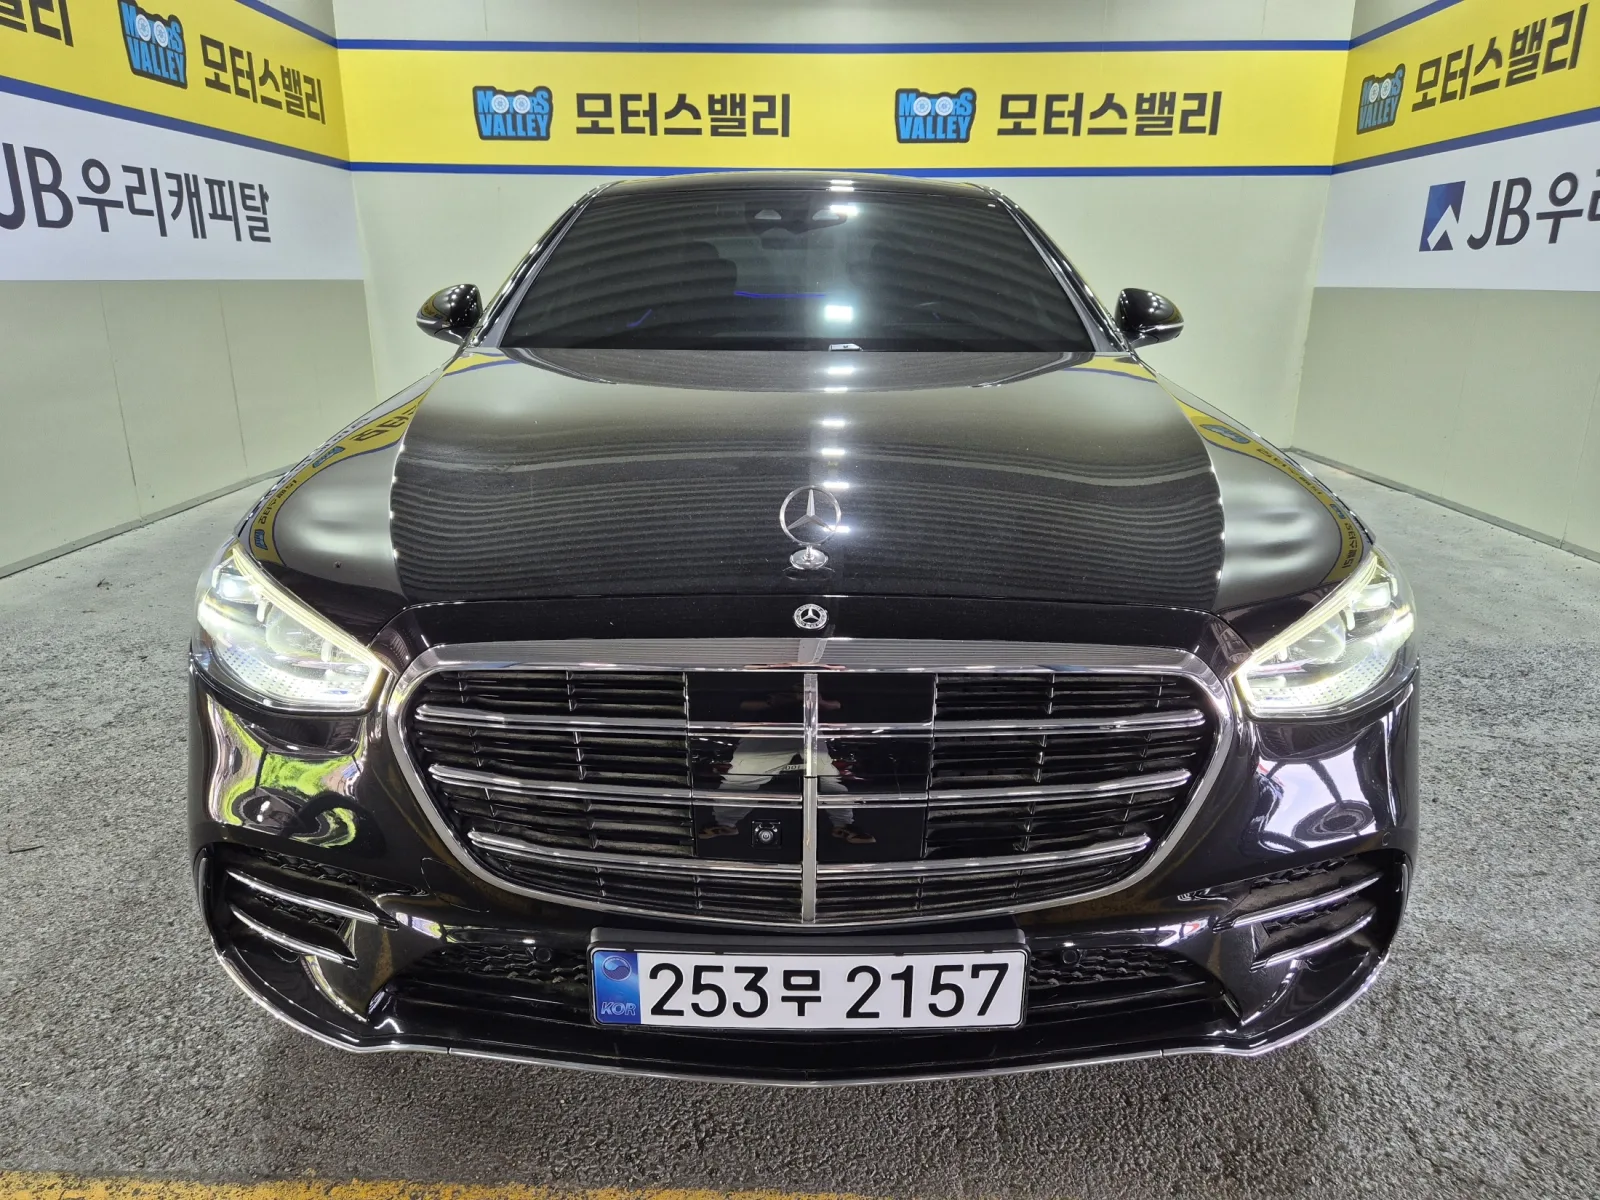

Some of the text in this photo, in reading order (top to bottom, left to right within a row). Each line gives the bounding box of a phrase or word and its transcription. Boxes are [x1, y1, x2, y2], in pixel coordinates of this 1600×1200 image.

[127, 36, 185, 83] VALLEY
[200, 34, 326, 125] 모터스밸리
[1411, 3, 1589, 112] 모터스밸리
[479, 113, 549, 137] VALLEY
[576, 92, 791, 137] 모터스밸리
[899, 116, 972, 140] VALLEY
[997, 91, 1222, 136] 모터스밸리
[1358, 95, 1400, 130] VALLEY
[600, 1001, 637, 1016] KOR
[648, 962, 1010, 1018] 253무 2157
